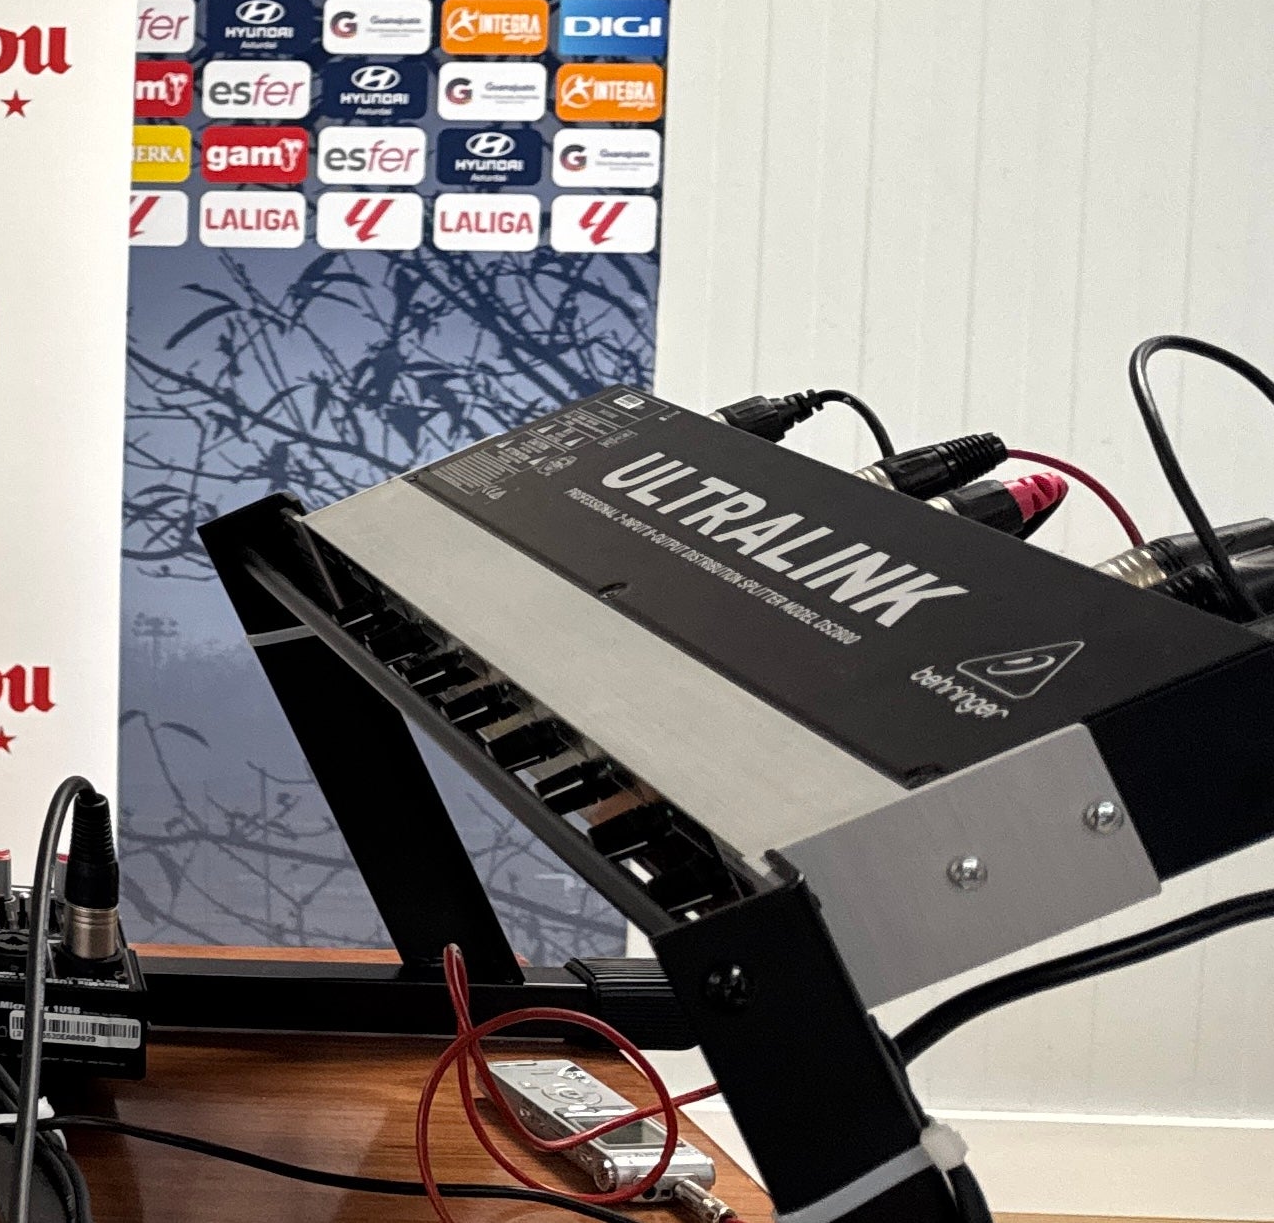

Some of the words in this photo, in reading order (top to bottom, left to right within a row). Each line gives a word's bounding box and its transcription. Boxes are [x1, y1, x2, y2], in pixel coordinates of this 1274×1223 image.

[138, 10, 188, 40] fer
[225, 27, 294, 38] HYUNDAI
[479, 14, 540, 34] INTEGRA
[563, 16, 661, 37] DIGI
[209, 77, 305, 106] esfer
[340, 93, 409, 104] HYUNDAI
[594, 82, 655, 102] INTEGRA
[324, 140, 419, 172] esfer
[455, 159, 524, 171] HYUNDAI
[206, 208, 299, 231] LALIGA
[440, 211, 533, 233] LALIGA
[601, 450, 969, 628] ULTRALINK
[909, 664, 1010, 720] behringer
